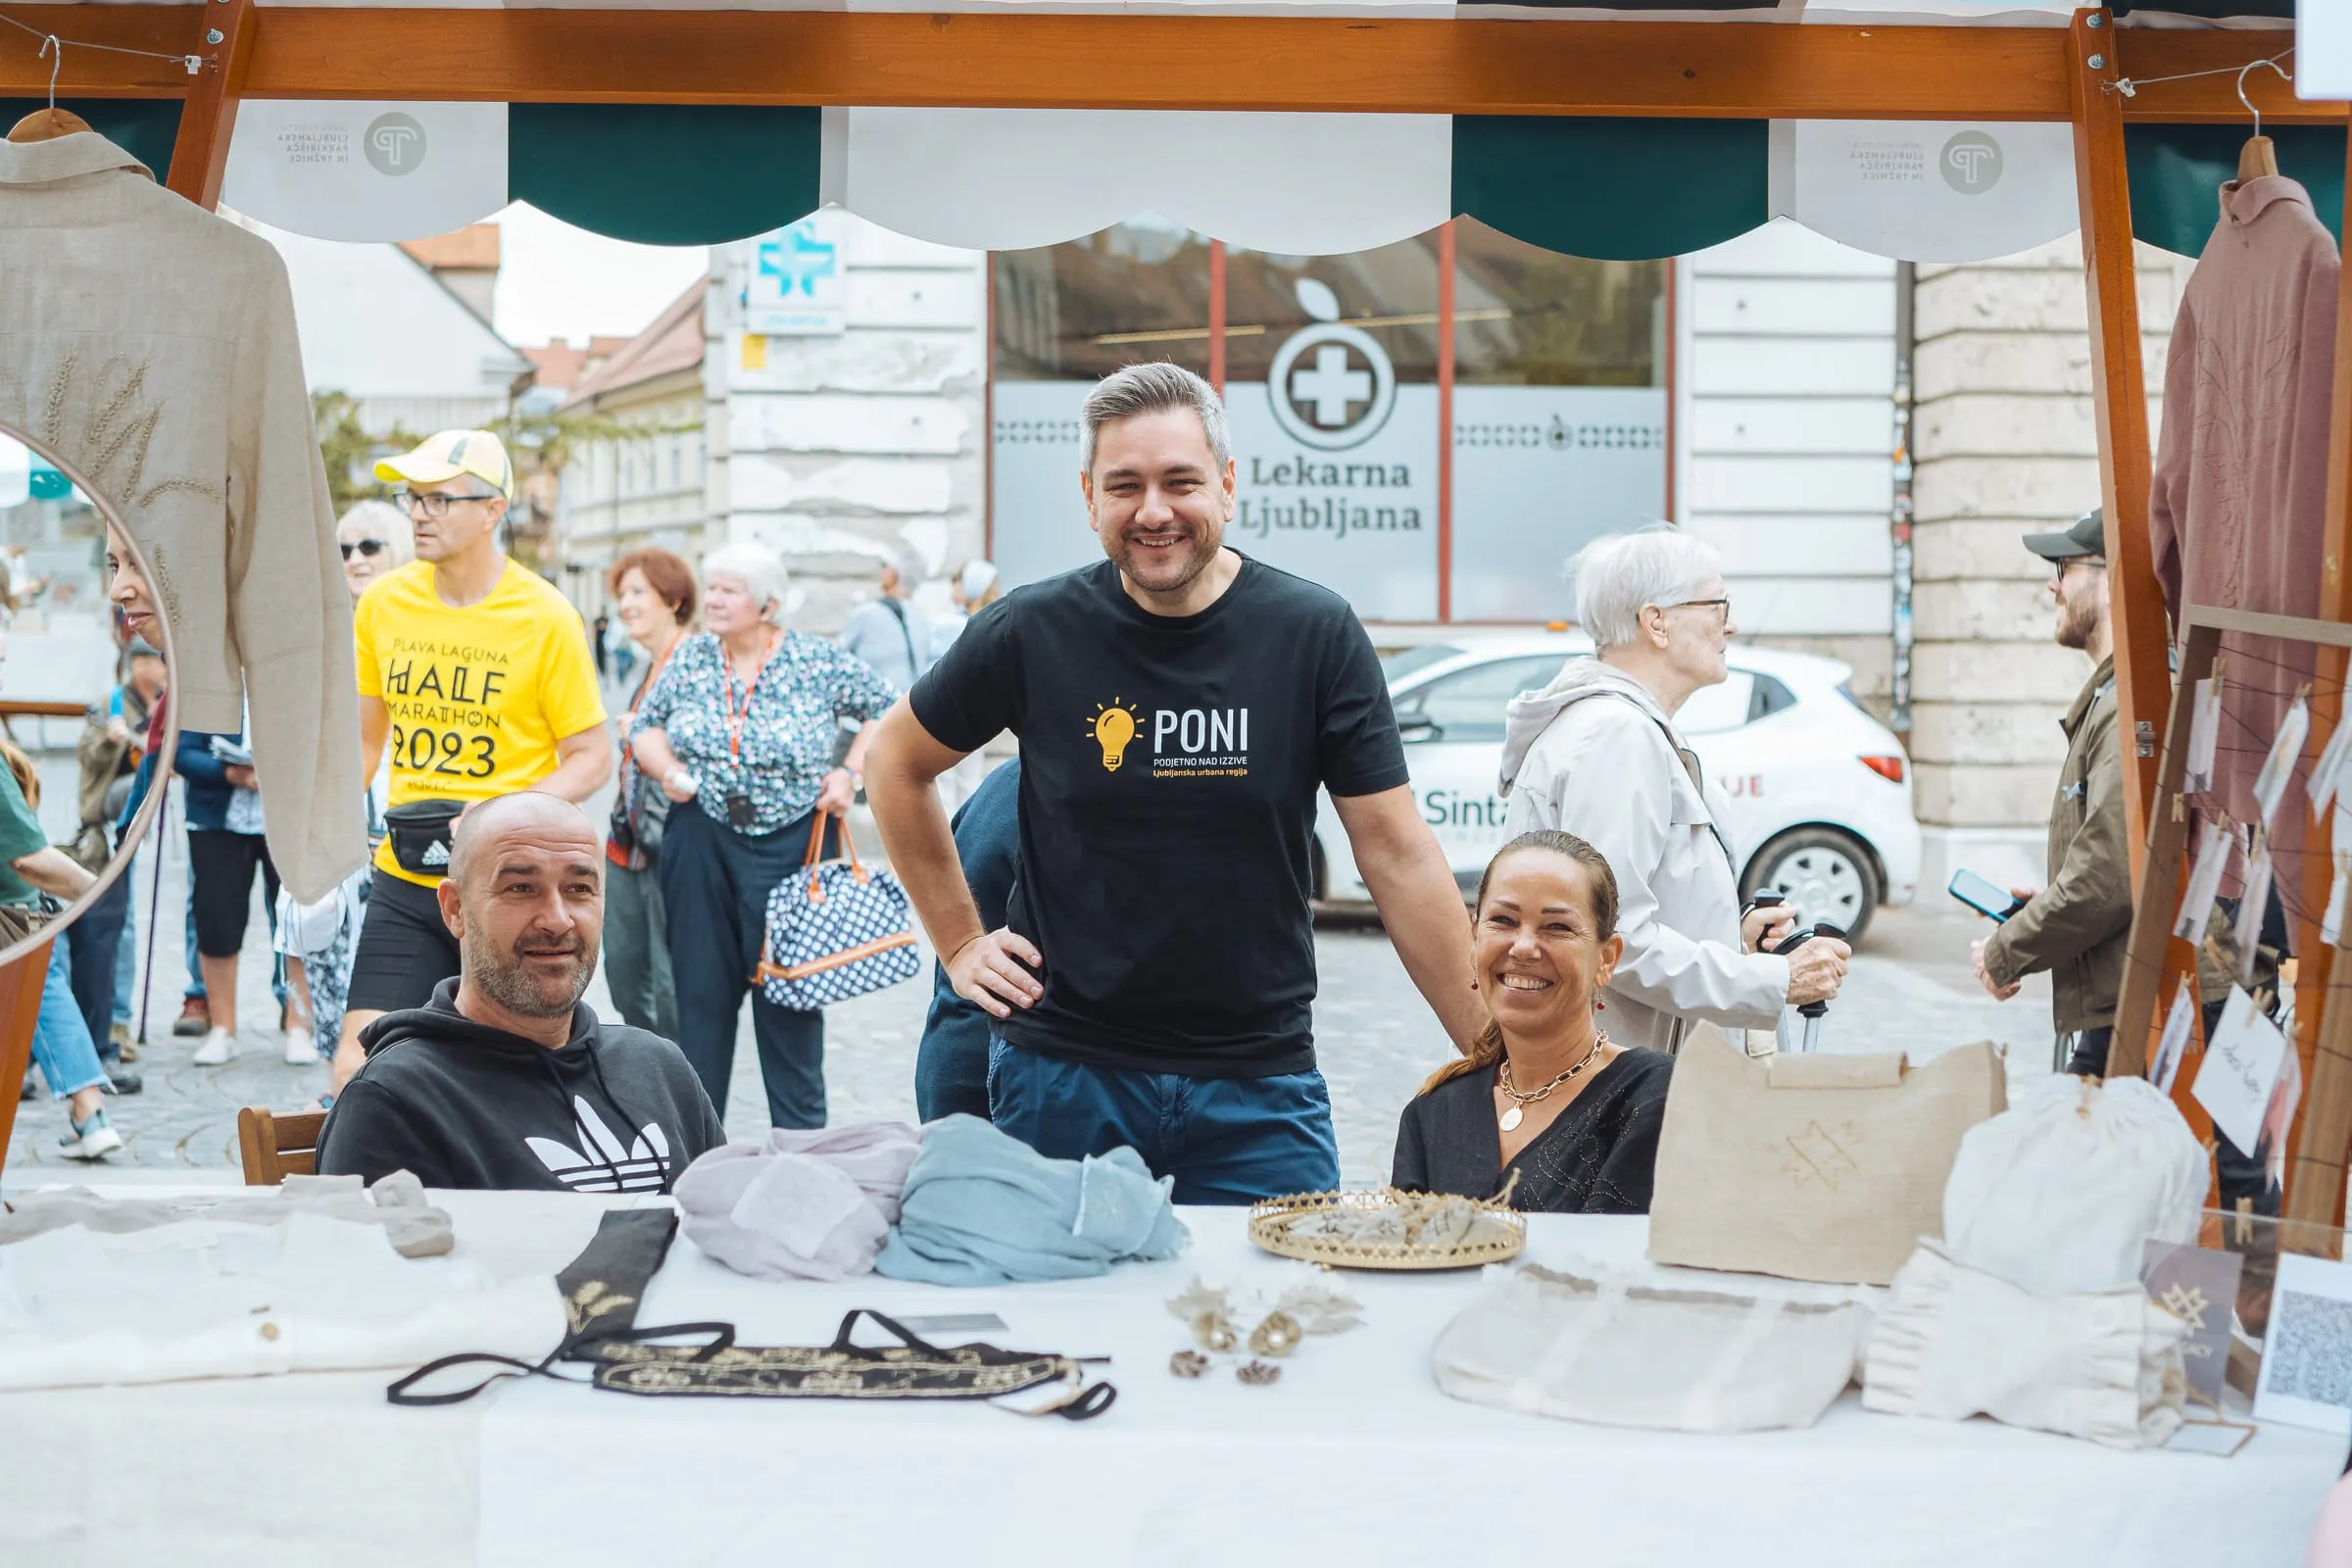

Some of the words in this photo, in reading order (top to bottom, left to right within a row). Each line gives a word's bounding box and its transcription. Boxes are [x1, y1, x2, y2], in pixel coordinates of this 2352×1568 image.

[1251, 455, 1411, 488] Lekarna
[1239, 496, 1423, 539] Ljubljana
[393, 637, 436, 655] PLAVA
[441, 642, 509, 665] LAGUNA
[386, 658, 506, 706] HALF
[388, 701, 501, 729] MARATHON
[1154, 708, 1248, 754] PONI
[393, 724, 496, 777] 2023
[1153, 758, 1197, 768] PODJETNO
[1199, 758, 1217, 766] NAD
[1219, 757, 1248, 765] IZZIVE
[1152, 769, 1196, 778] Ljubljanska
[1226, 768, 1248, 777] regija
